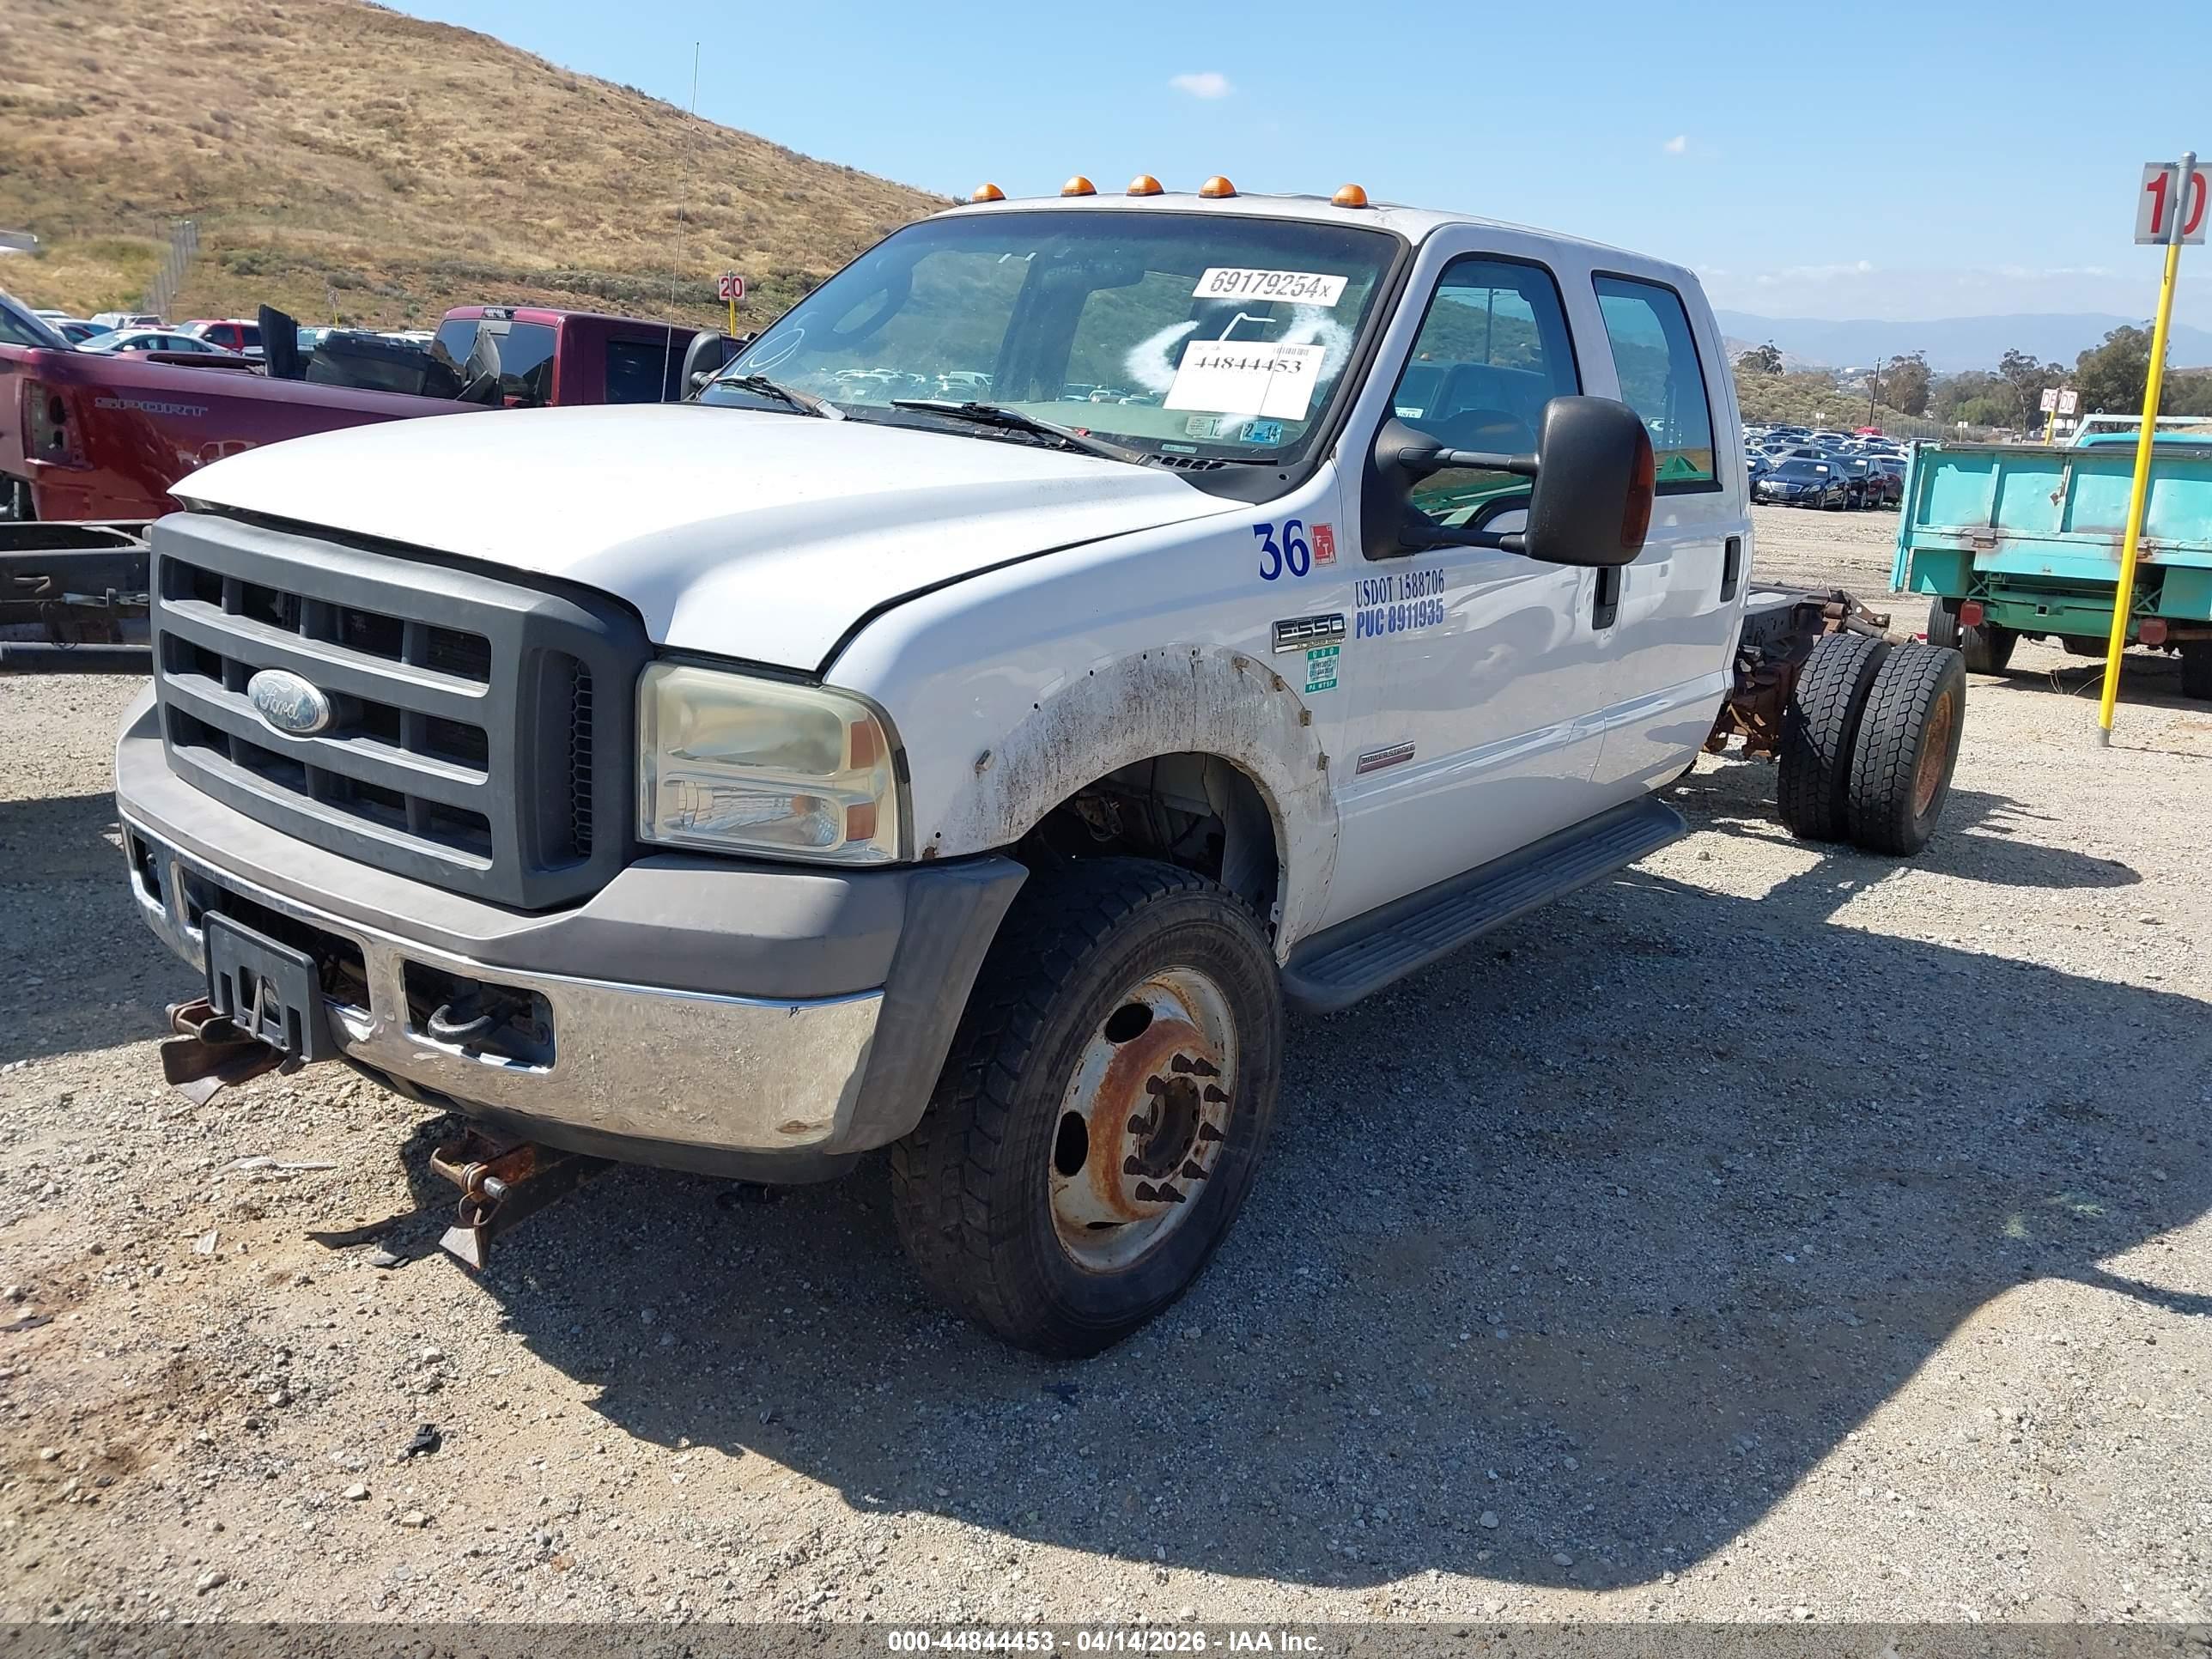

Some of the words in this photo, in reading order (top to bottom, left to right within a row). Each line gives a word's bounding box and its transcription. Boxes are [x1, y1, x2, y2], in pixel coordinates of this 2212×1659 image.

[720, 276, 743, 298] 20
[1194, 356, 1302, 374] 44844453
[94, 398, 209, 418] SPORT
[1253, 520, 1310, 581] 36
[1355, 576, 1395, 609] USDOT
[1398, 568, 1445, 601] 1588706
[1356, 608, 1385, 640] PUC
[1388, 598, 1444, 634] 8911935
[257, 678, 301, 720] Ford
[1363, 752, 1389, 764] POWER
